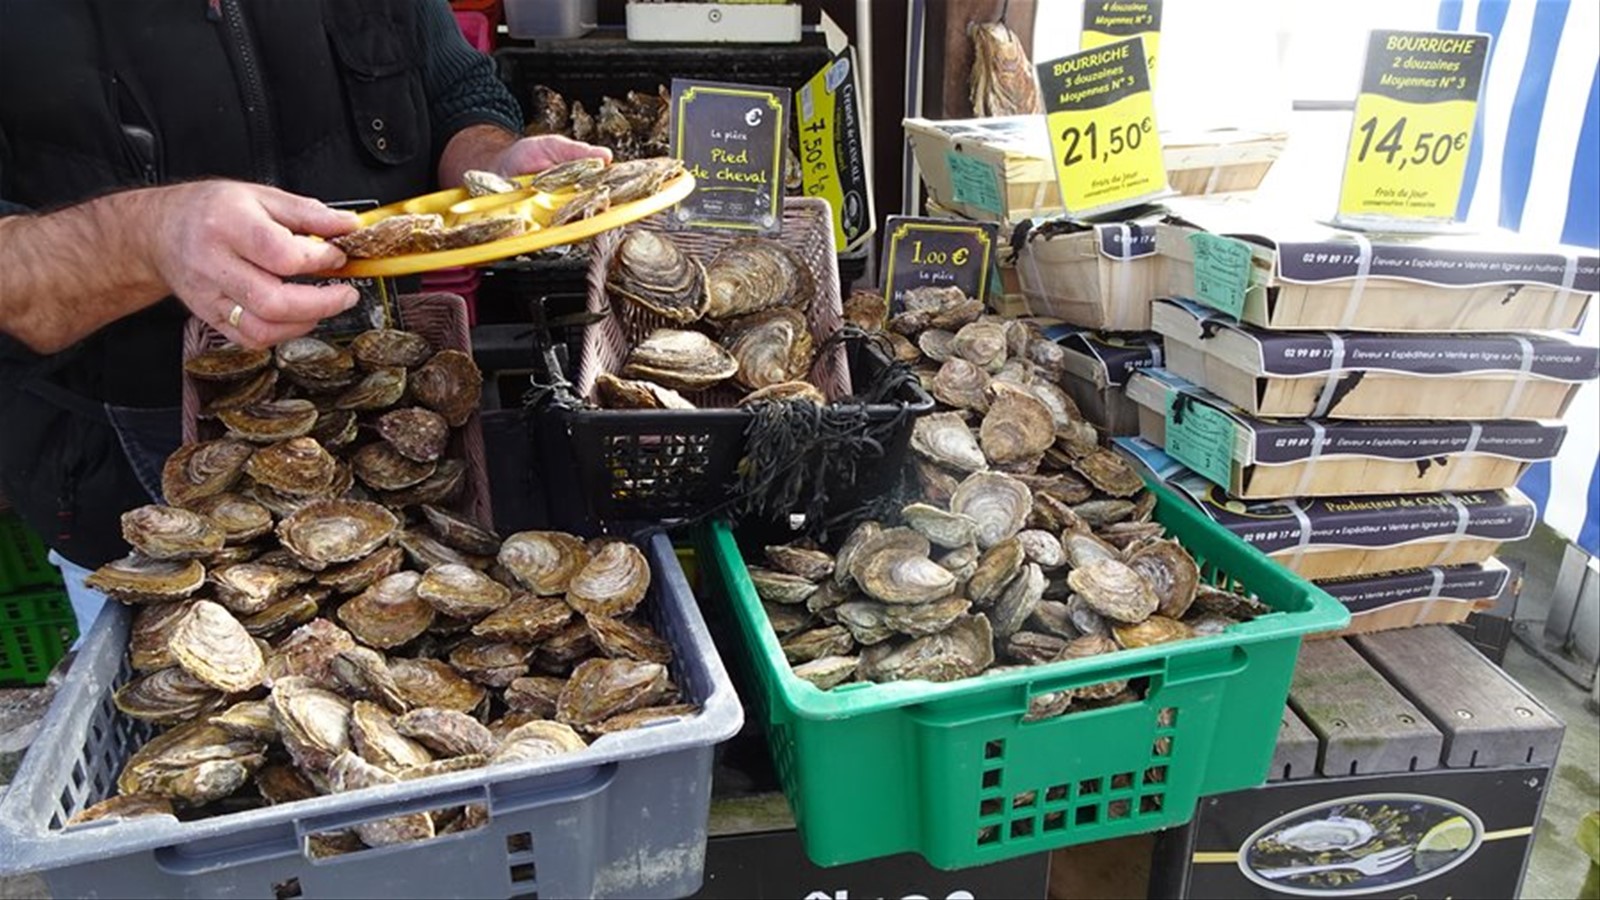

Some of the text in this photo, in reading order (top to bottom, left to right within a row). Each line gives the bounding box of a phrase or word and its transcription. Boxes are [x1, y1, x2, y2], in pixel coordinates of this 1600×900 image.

[1102, 1, 1148, 12] 4 douzaines
[1095, 15, 1134, 27] Moyennes
[1384, 34, 1477, 55] BOURRICHE
[1053, 45, 1131, 77] BOURRICHE
[1392, 56, 1460, 72] 2 douzaines
[1064, 65, 1125, 88] 3 douzaines
[1379, 73, 1438, 90] Moyennes
[1457, 76, 1467, 90] 3
[1059, 84, 1110, 105] Moyennes
[1127, 75, 1136, 86] 3
[1060, 116, 1152, 168] 21,50€
[1357, 116, 1468, 172] 14,50€
[710, 148, 749, 165] Pied
[690, 164, 768, 184] de cheval
[1302, 253, 1315, 264] 02
[1315, 253, 1328, 264] 99
[1328, 253, 1341, 264] 89
[1342, 253, 1354, 264] 17
[1284, 348, 1295, 358] 02
[1296, 348, 1308, 358] 99
[1308, 348, 1321, 358] 89
[1322, 348, 1334, 358] 17
[1324, 499, 1398, 513] Producteur
[1400, 496, 1415, 508] de
